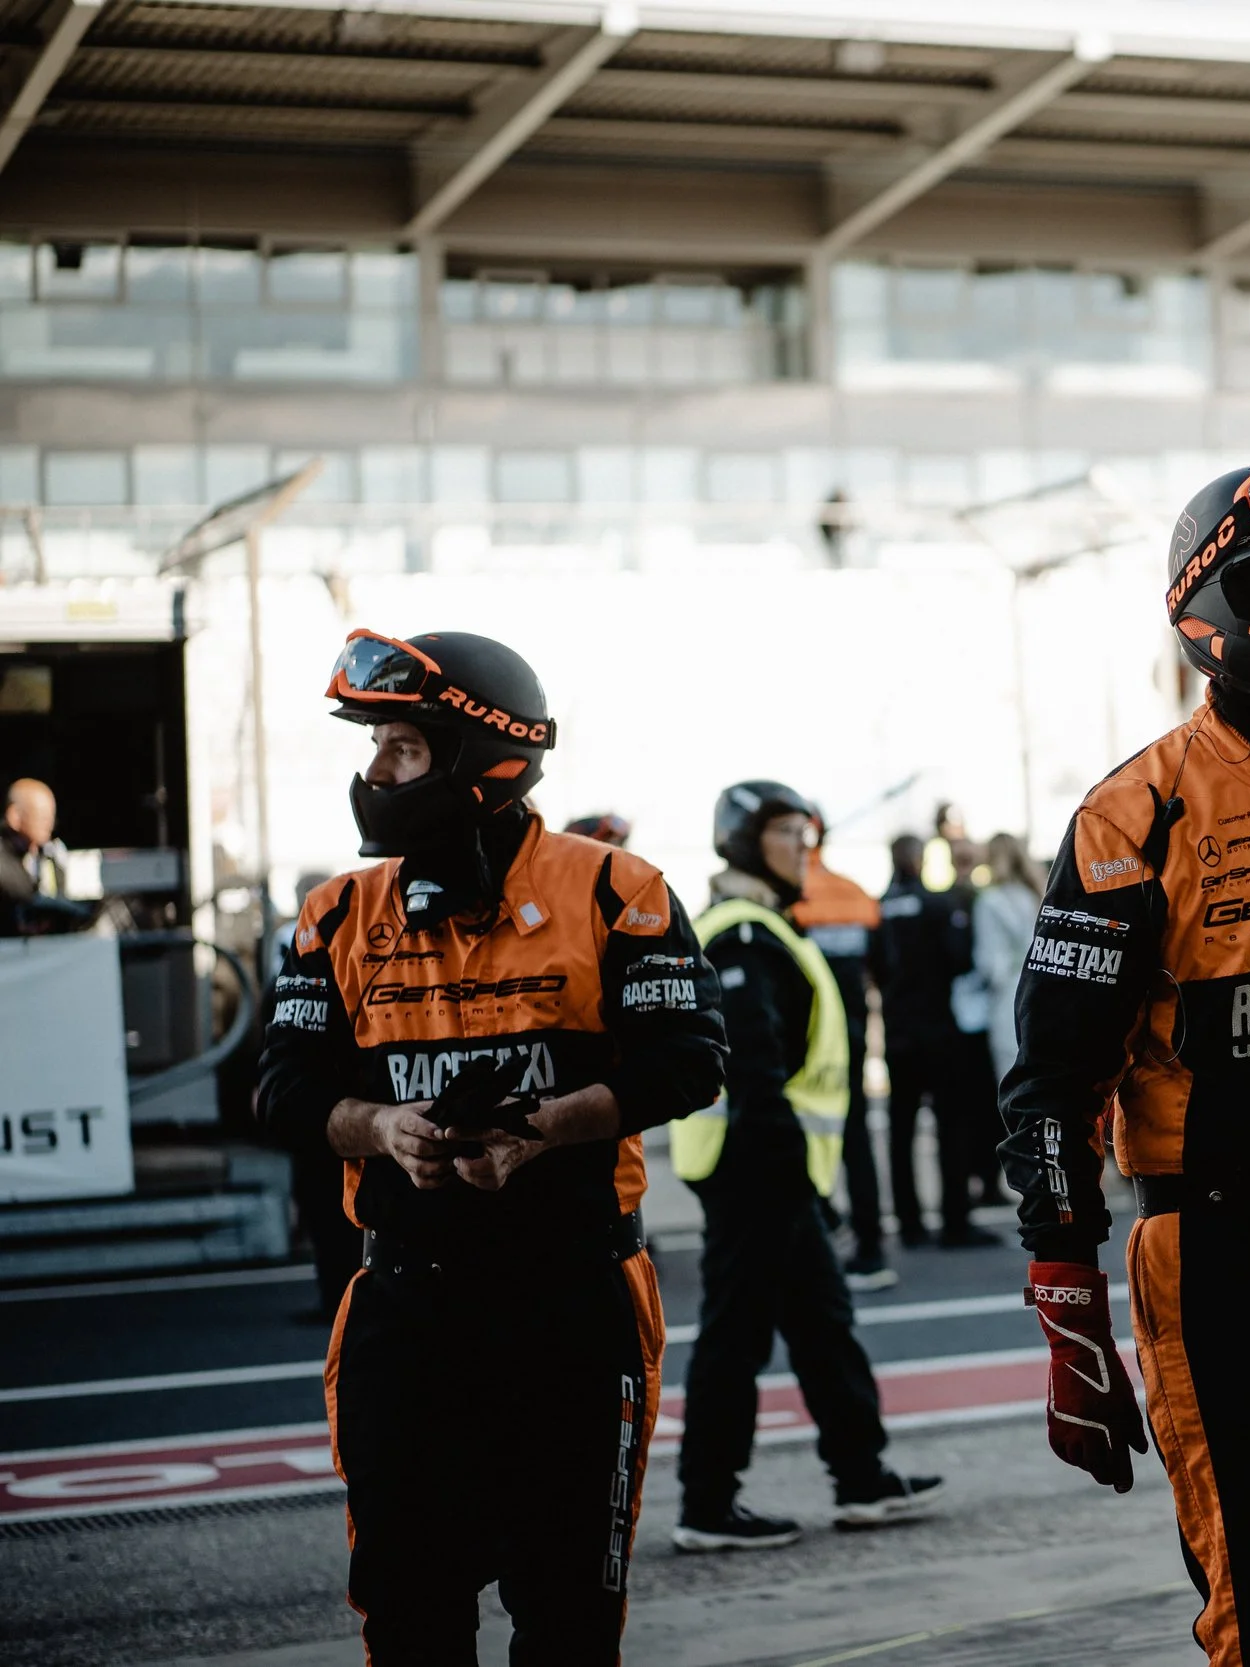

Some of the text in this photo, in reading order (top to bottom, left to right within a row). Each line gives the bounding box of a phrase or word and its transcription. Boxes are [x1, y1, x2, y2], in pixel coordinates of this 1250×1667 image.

[1089, 856, 1139, 882] freem
[1027, 961, 1118, 985] under8.de
[1034, 1284, 1093, 1306] sparco
